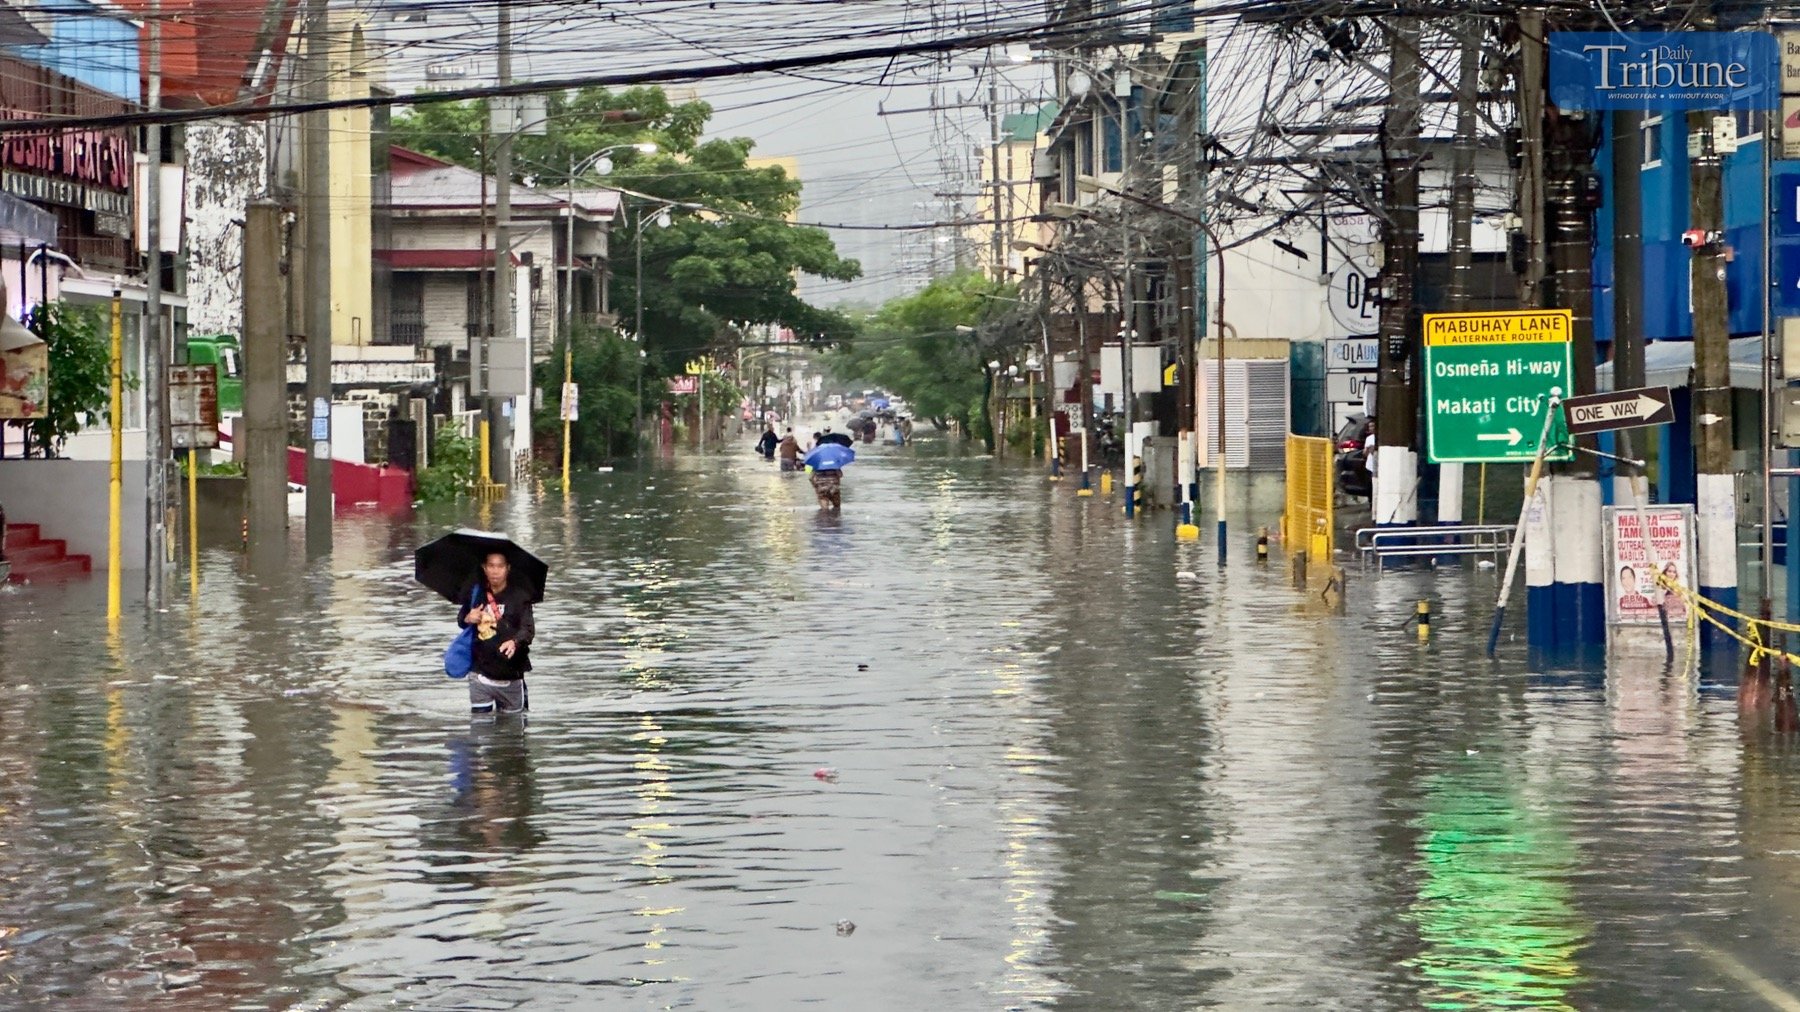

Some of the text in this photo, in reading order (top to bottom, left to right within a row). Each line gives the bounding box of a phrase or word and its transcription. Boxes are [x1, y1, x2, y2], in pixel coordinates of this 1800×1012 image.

[2, 170, 73, 203] UNLIMITED
[1435, 317, 1561, 333] MABUHAY LANE
[1452, 334, 1506, 343] ALTERNATE
[1512, 333, 1544, 341] ROUTE
[1436, 359, 1561, 378] Osmeña Hi-way
[1437, 397, 1541, 416] Makati City
[1576, 402, 1638, 421] ONE WAY
